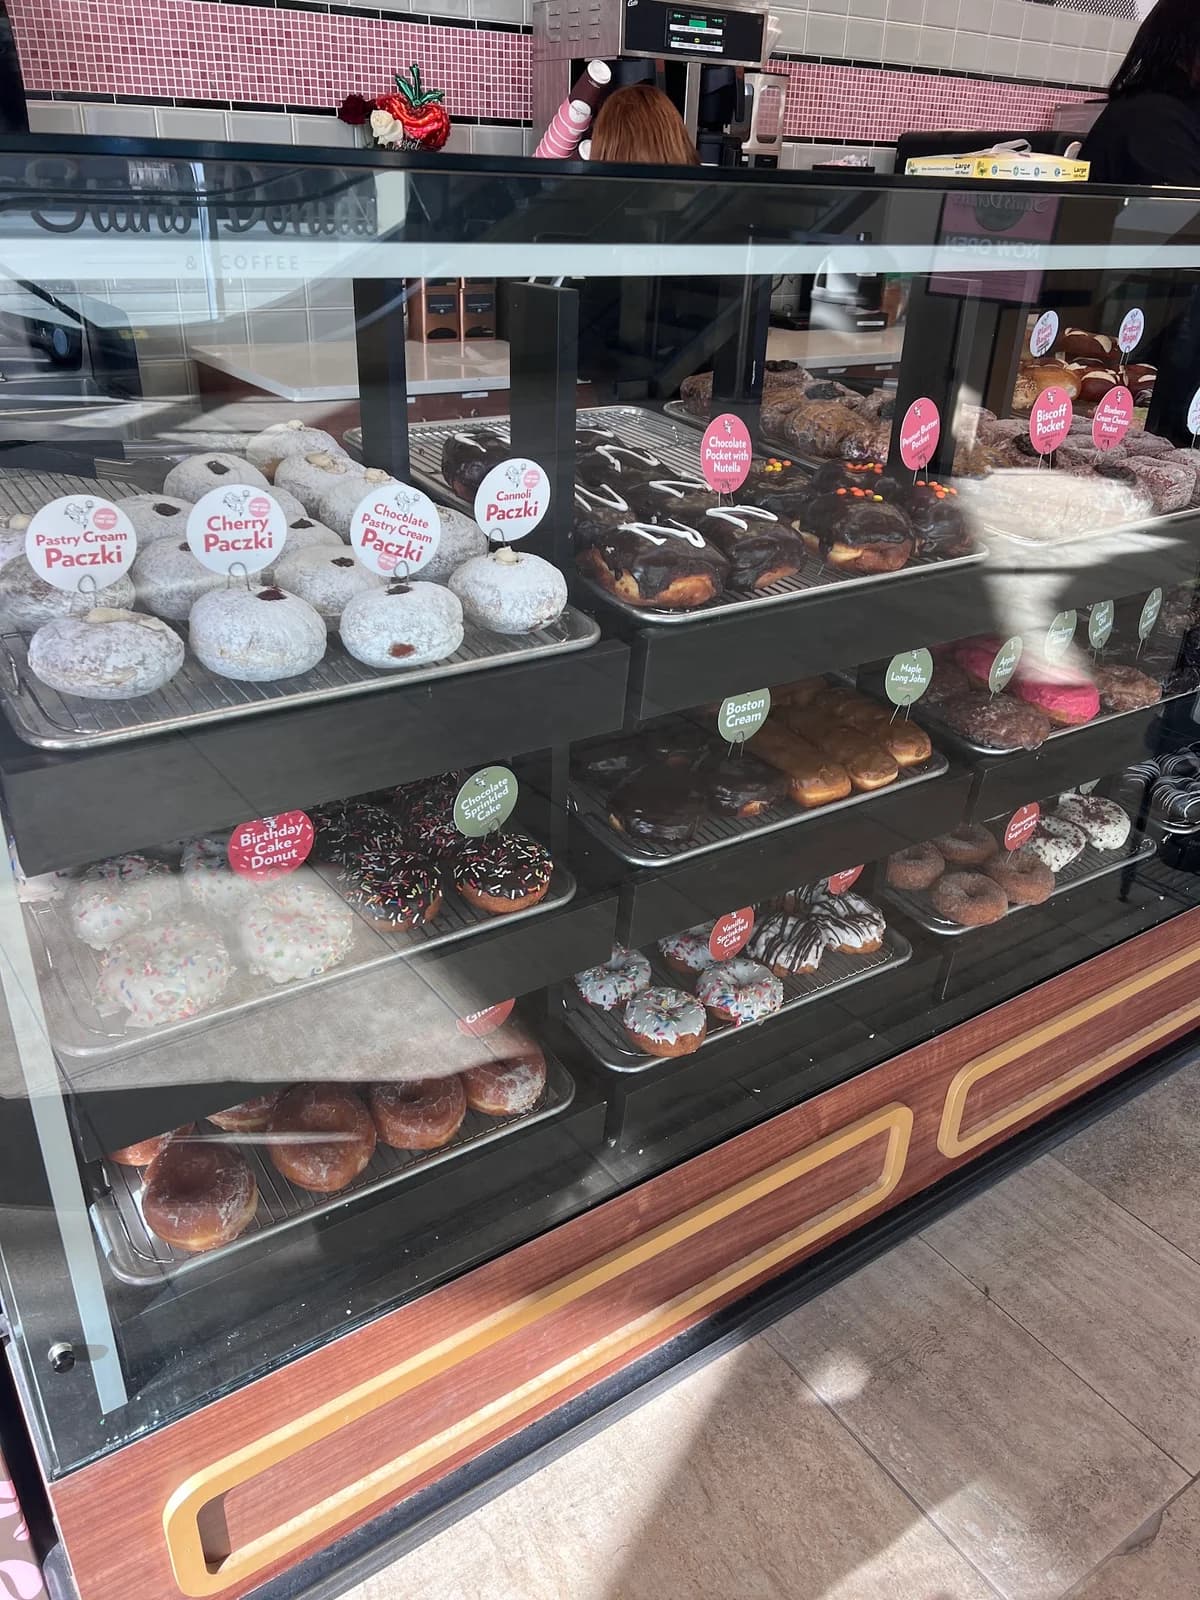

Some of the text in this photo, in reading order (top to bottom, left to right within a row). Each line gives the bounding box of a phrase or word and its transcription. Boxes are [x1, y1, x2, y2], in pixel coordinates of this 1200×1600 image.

[221, 254, 299, 270] COFFEE
[1036, 404, 1067, 422] Biscoff
[1036, 420, 1065, 435] Pocket
[708, 436, 747, 448] Chocolate
[705, 449, 749, 460] Pocket with
[713, 462, 741, 473] Nutella
[496, 488, 532, 501] Cannoli
[373, 503, 429, 529] Chocolate
[486, 502, 539, 521] Paczki
[206, 515, 269, 532] Cherry
[361, 513, 433, 544] Pastry Cream
[35, 531, 128, 547] Pastry Cream
[203, 532, 274, 552] Paczki
[360, 528, 424, 562] Paczki
[44, 545, 123, 568] Paczki
[891, 672, 926, 684] Long John
[900, 664, 922, 675] Maple
[726, 699, 765, 716] Boston
[726, 711, 762, 728] Cream
[461, 778, 508, 810] Chocolate
[464, 785, 509, 819] Sprinkled
[477, 803, 501, 821] Cake
[240, 822, 304, 847] Birthday
[254, 839, 293, 855] Cake
[251, 849, 298, 869] Donut
[716, 921, 749, 944] Sprinkled
[722, 917, 745, 932] Vanilla
[723, 935, 741, 947] Cake
